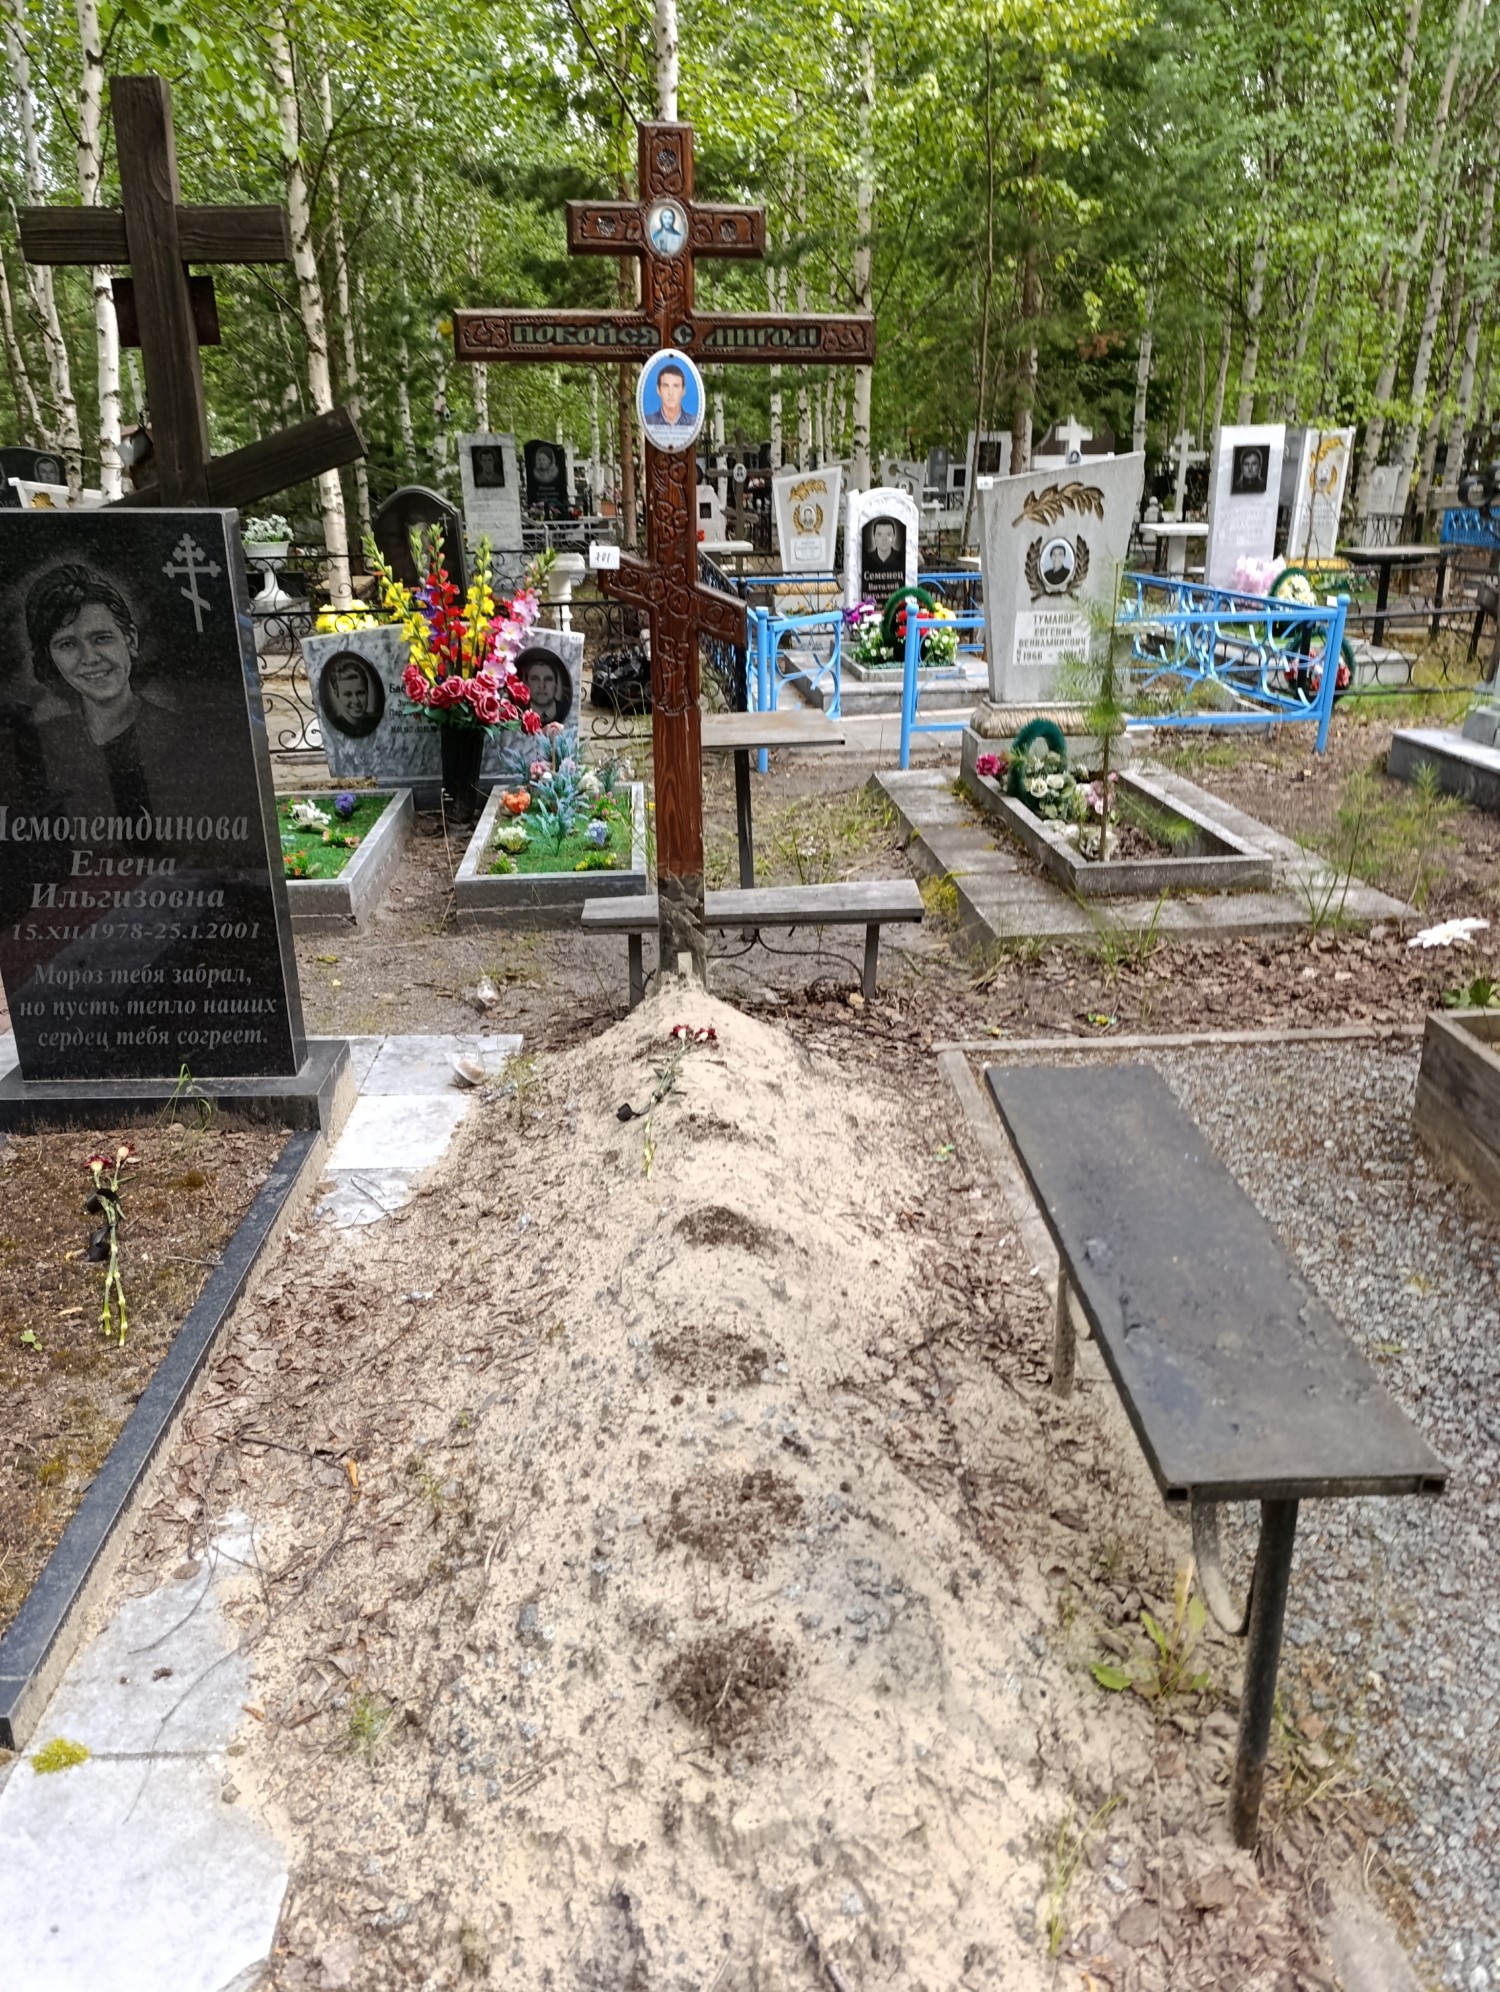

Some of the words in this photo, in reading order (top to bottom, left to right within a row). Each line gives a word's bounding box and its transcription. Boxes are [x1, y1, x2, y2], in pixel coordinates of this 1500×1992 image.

[69, 850, 177, 876] Елена
[29, 883, 225, 909] Ильгизовна
[34, 964, 104, 990] Мороз
[110, 963, 166, 984] тебя
[172, 963, 252, 989] забрал,
[19, 1001, 46, 1017] но
[52, 1000, 120, 1021] пусть
[127, 1000, 196, 1016] тепло
[203, 998, 277, 1014] наших
[37, 1026, 109, 1050] сердец
[116, 1025, 169, 1046] тебя
[177, 1029, 268, 1050] согреет.
